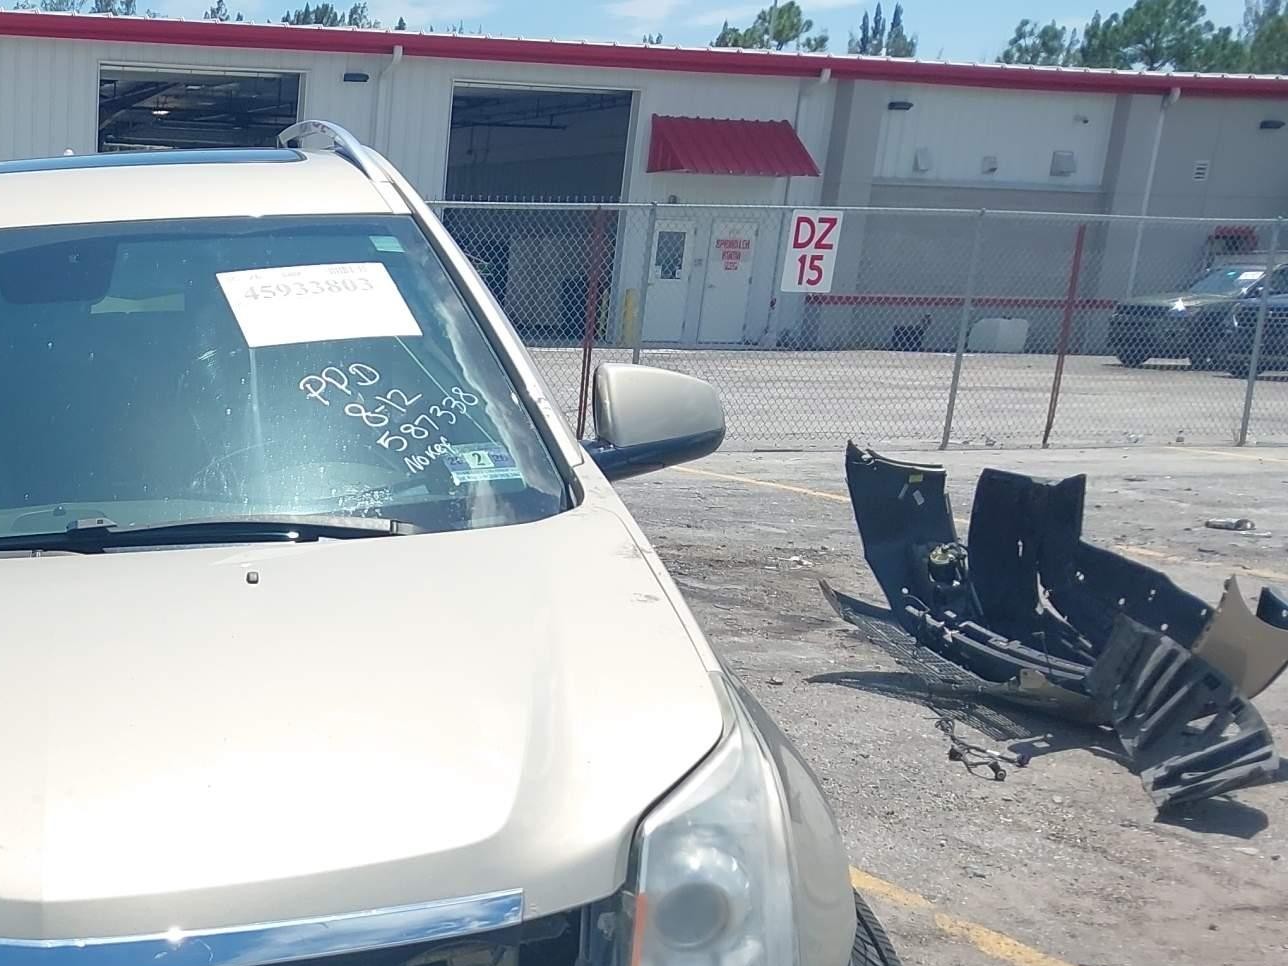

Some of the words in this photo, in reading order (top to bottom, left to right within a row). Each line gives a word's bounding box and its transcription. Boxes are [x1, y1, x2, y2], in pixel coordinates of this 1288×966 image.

[792, 216, 838, 250] DZ
[797, 254, 824, 286] 15
[244, 277, 374, 301] 45933803
[376, 385, 479, 452] 587338
[471, 452, 486, 466] 2
